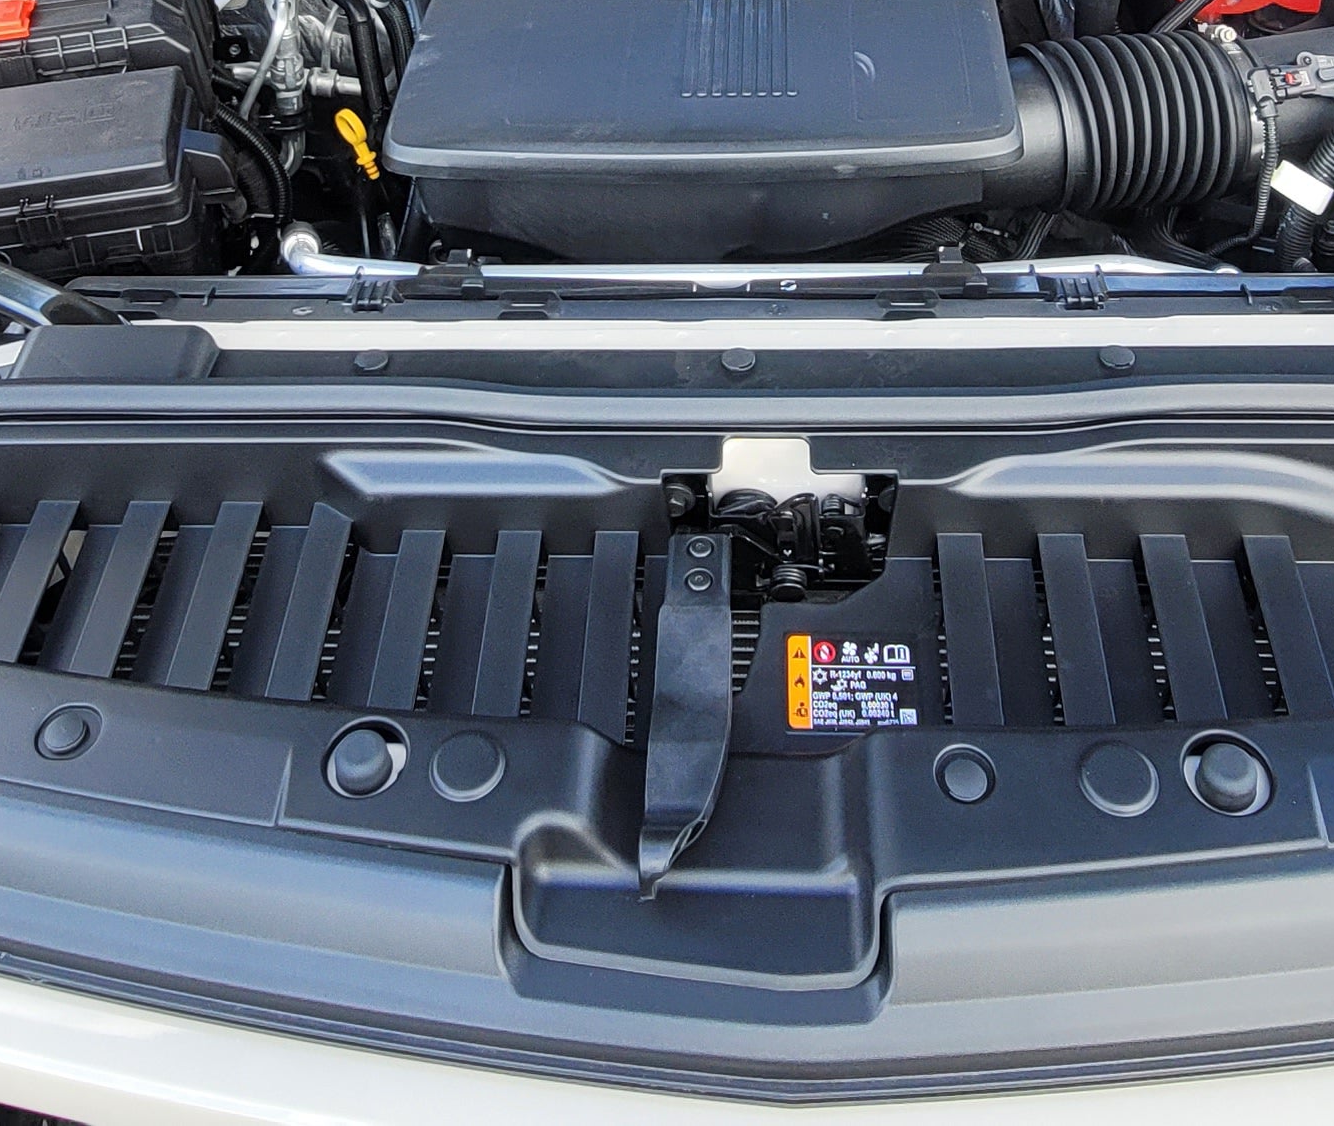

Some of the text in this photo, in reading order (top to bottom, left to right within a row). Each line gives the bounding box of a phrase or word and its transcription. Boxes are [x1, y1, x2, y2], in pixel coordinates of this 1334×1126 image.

[841, 655, 860, 663] AUTO
[887, 671, 897, 682] kg
[812, 691, 831, 700] GWP
[855, 692, 874, 701] GWP
[875, 692, 891, 702] (UK)
[813, 700, 838, 710] CO2eq
[813, 709, 838, 719] CO2eq
[839, 709, 856, 719] (UK)
